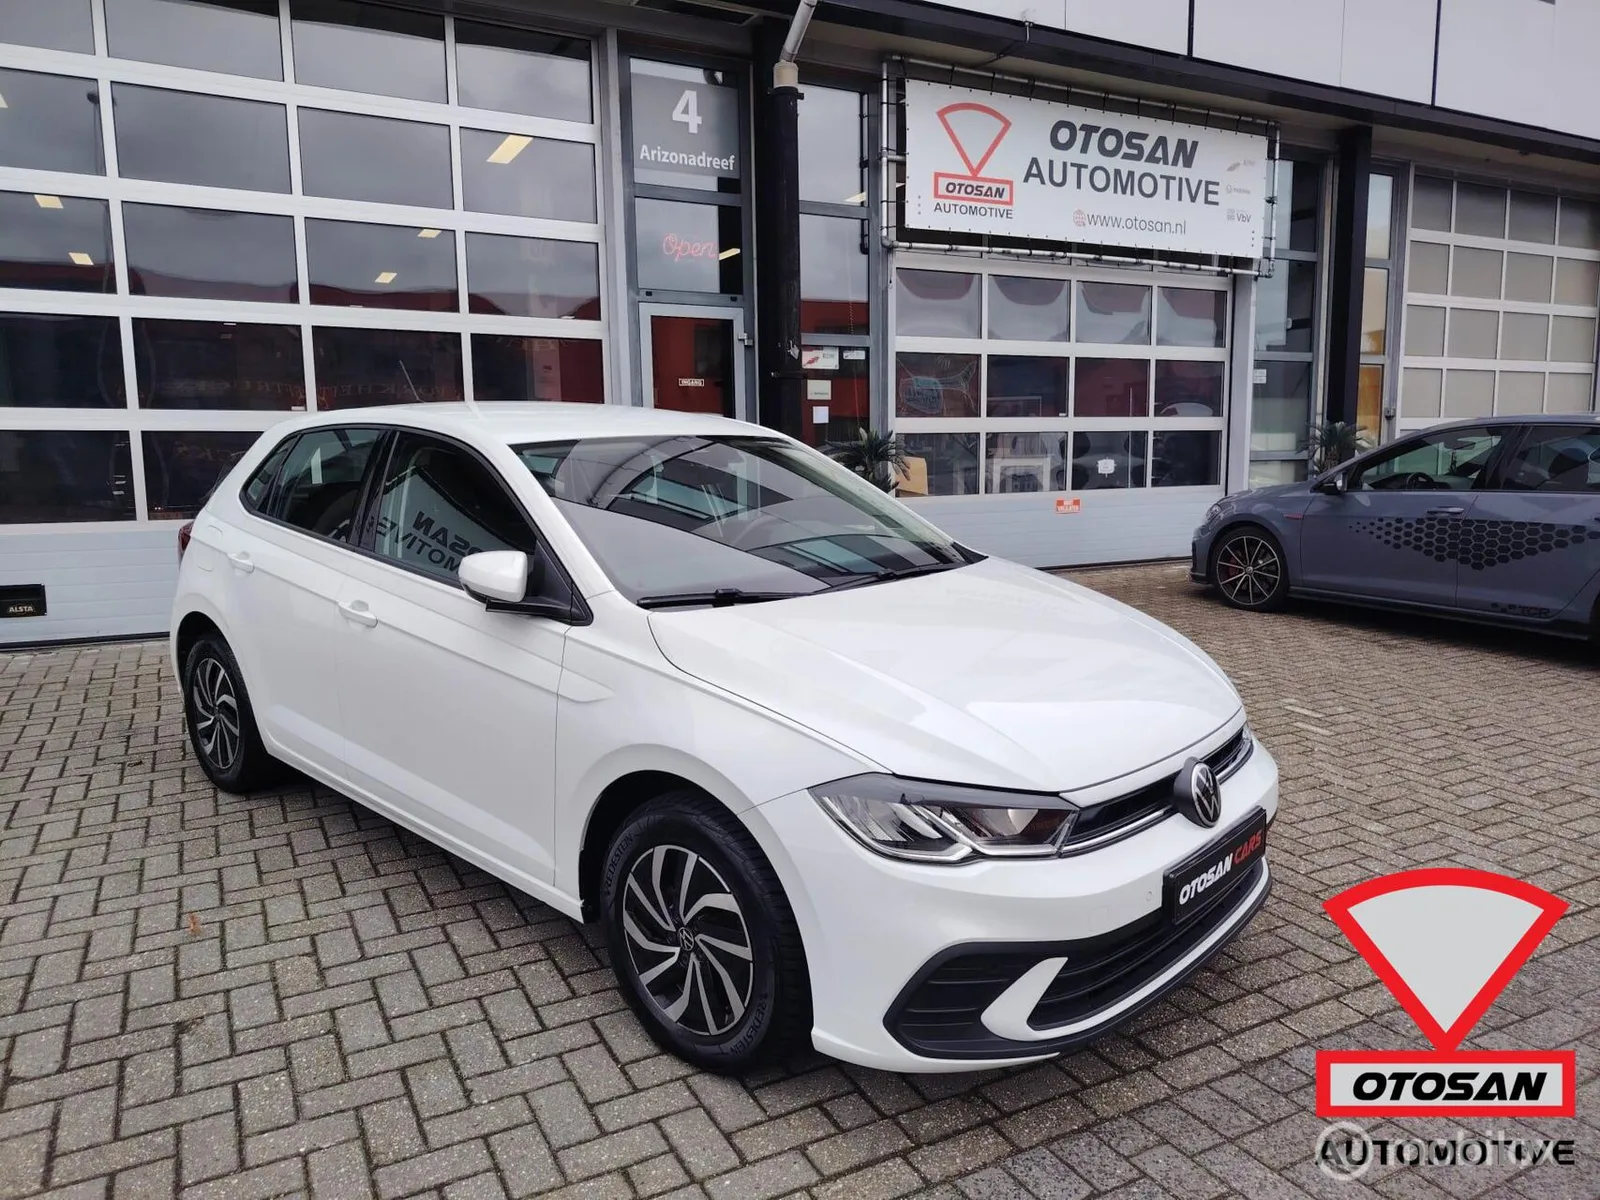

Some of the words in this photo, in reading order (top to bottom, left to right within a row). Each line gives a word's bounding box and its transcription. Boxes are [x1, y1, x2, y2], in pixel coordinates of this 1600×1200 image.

[671, 89, 703, 134] 4
[639, 144, 735, 171] Arizonadreef
[1050, 119, 1199, 169] OTOSAN
[945, 181, 1005, 199] OTOSAN
[1023, 157, 1220, 206] AUTOMOTIVE
[934, 202, 1013, 220] AUTOMOTIVE
[1087, 213, 1186, 235] www.otosan.nl
[662, 233, 717, 262] Open
[1179, 852, 1234, 905] OTOSAN
[1233, 829, 1263, 865] CARS
